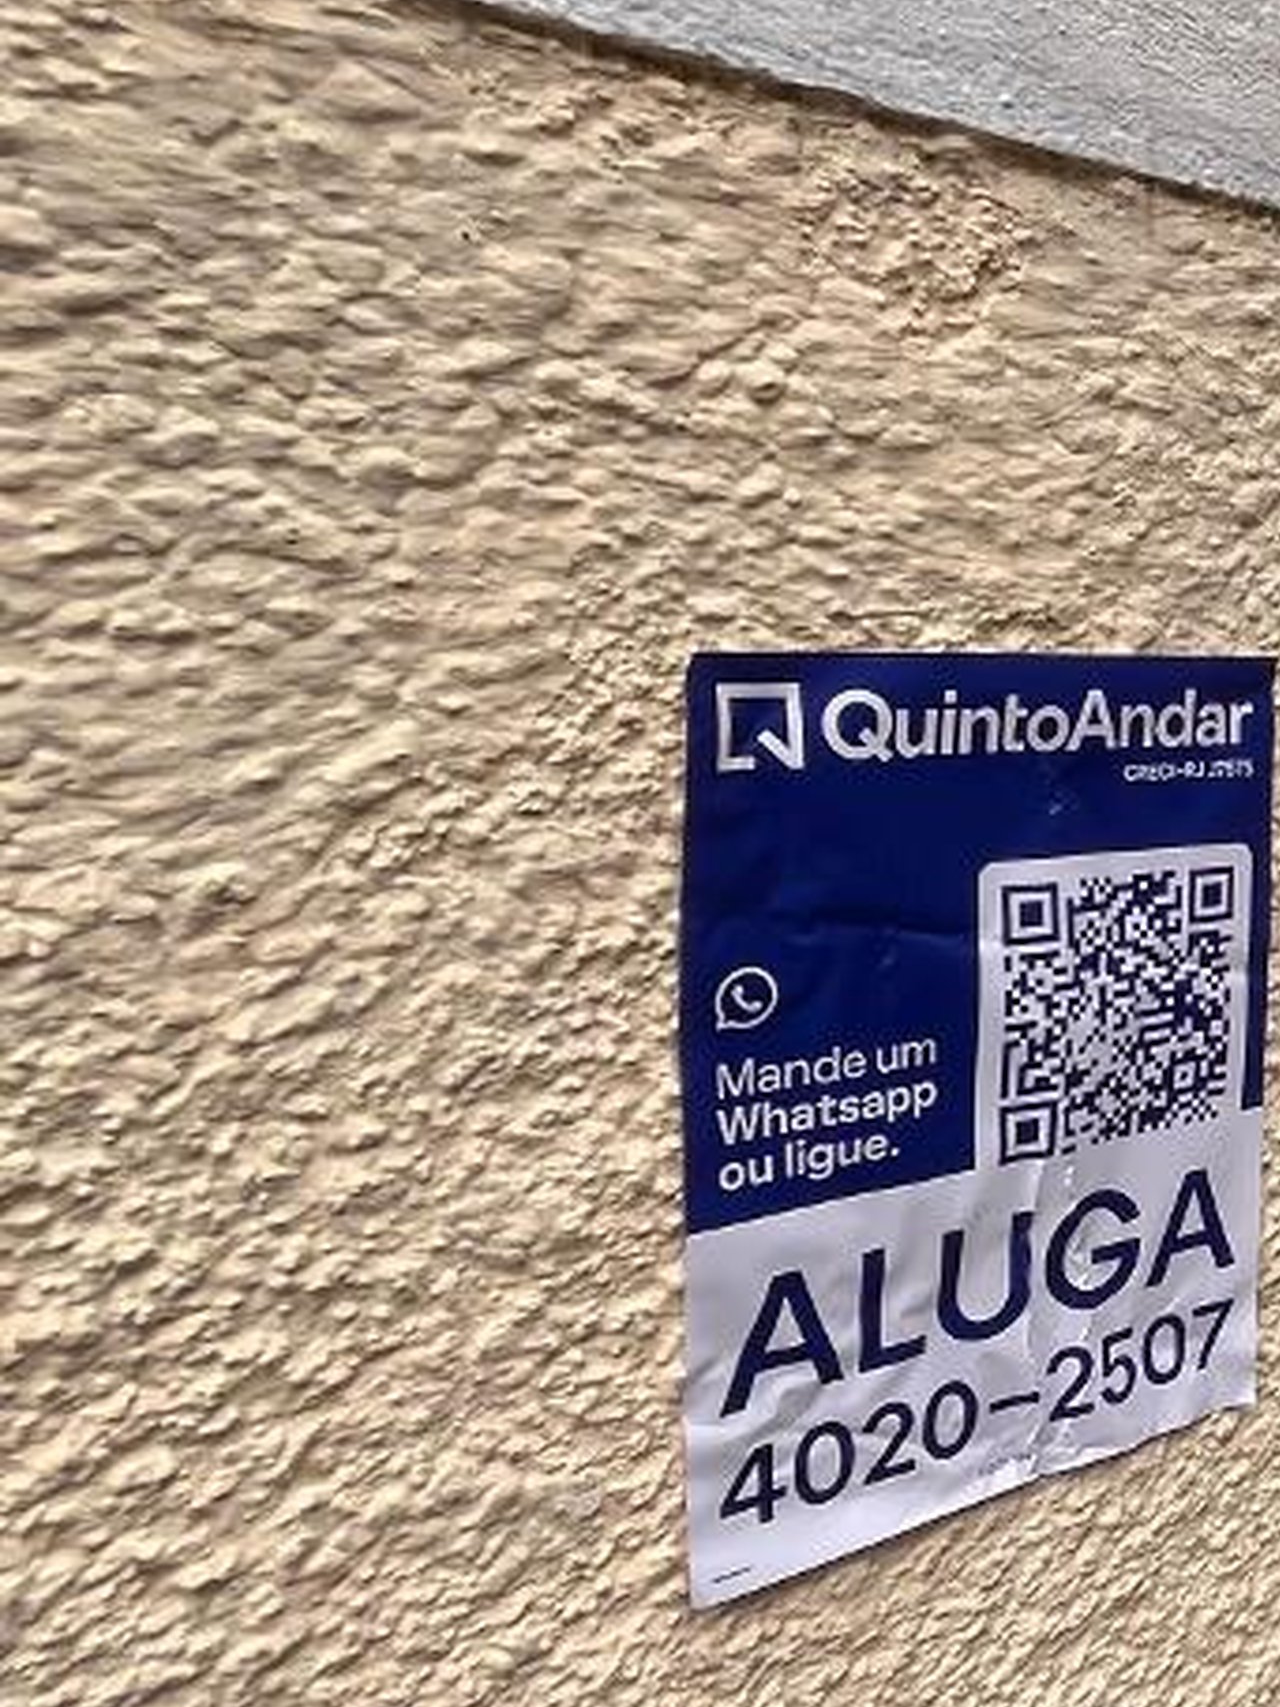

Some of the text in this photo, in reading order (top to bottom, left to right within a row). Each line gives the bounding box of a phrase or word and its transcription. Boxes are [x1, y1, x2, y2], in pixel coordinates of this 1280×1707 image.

[821, 688, 1254, 763] QuintoAndar
[716, 1039, 937, 1100] Mande um
[715, 1081, 938, 1146] Whatsapp
[718, 1134, 900, 1191] ou ligue.
[719, 1168, 1235, 1419] ALUGA
[718, 1298, 1236, 1525] 4020-2507
